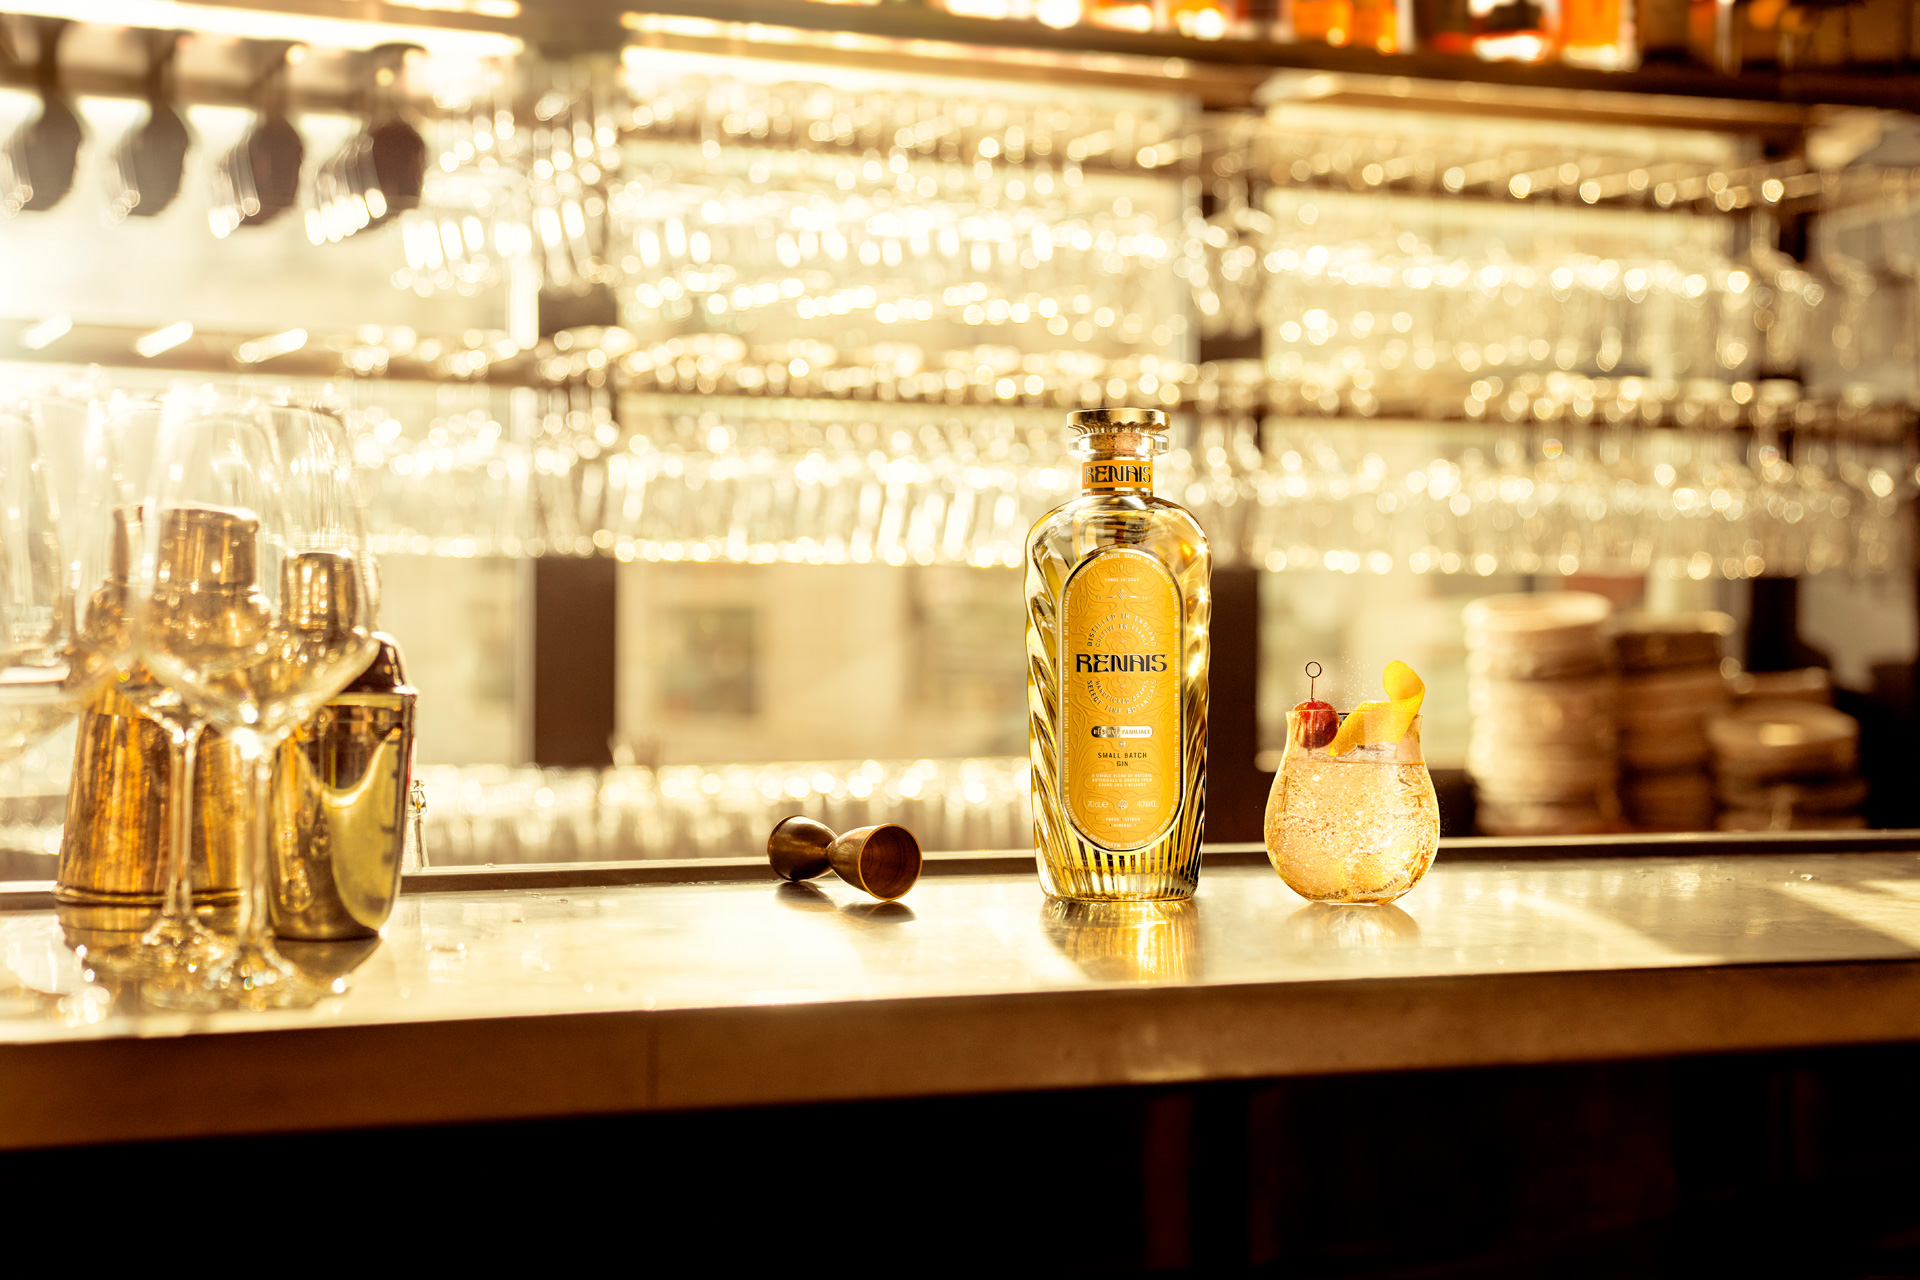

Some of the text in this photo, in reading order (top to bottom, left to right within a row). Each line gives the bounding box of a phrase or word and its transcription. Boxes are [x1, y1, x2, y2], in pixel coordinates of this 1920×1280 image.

[1084, 465, 1151, 484] RENAIS
[1087, 614, 1116, 647] DISTILLED
[1134, 615, 1157, 647] ENGLAND
[1131, 625, 1149, 646] FRANCE
[1076, 654, 1168, 673] RENAIS
[1087, 680, 1157, 714] SELECT FINE BOTANICALS
[1096, 680, 1149, 704] HANDPICKED GRAPES
